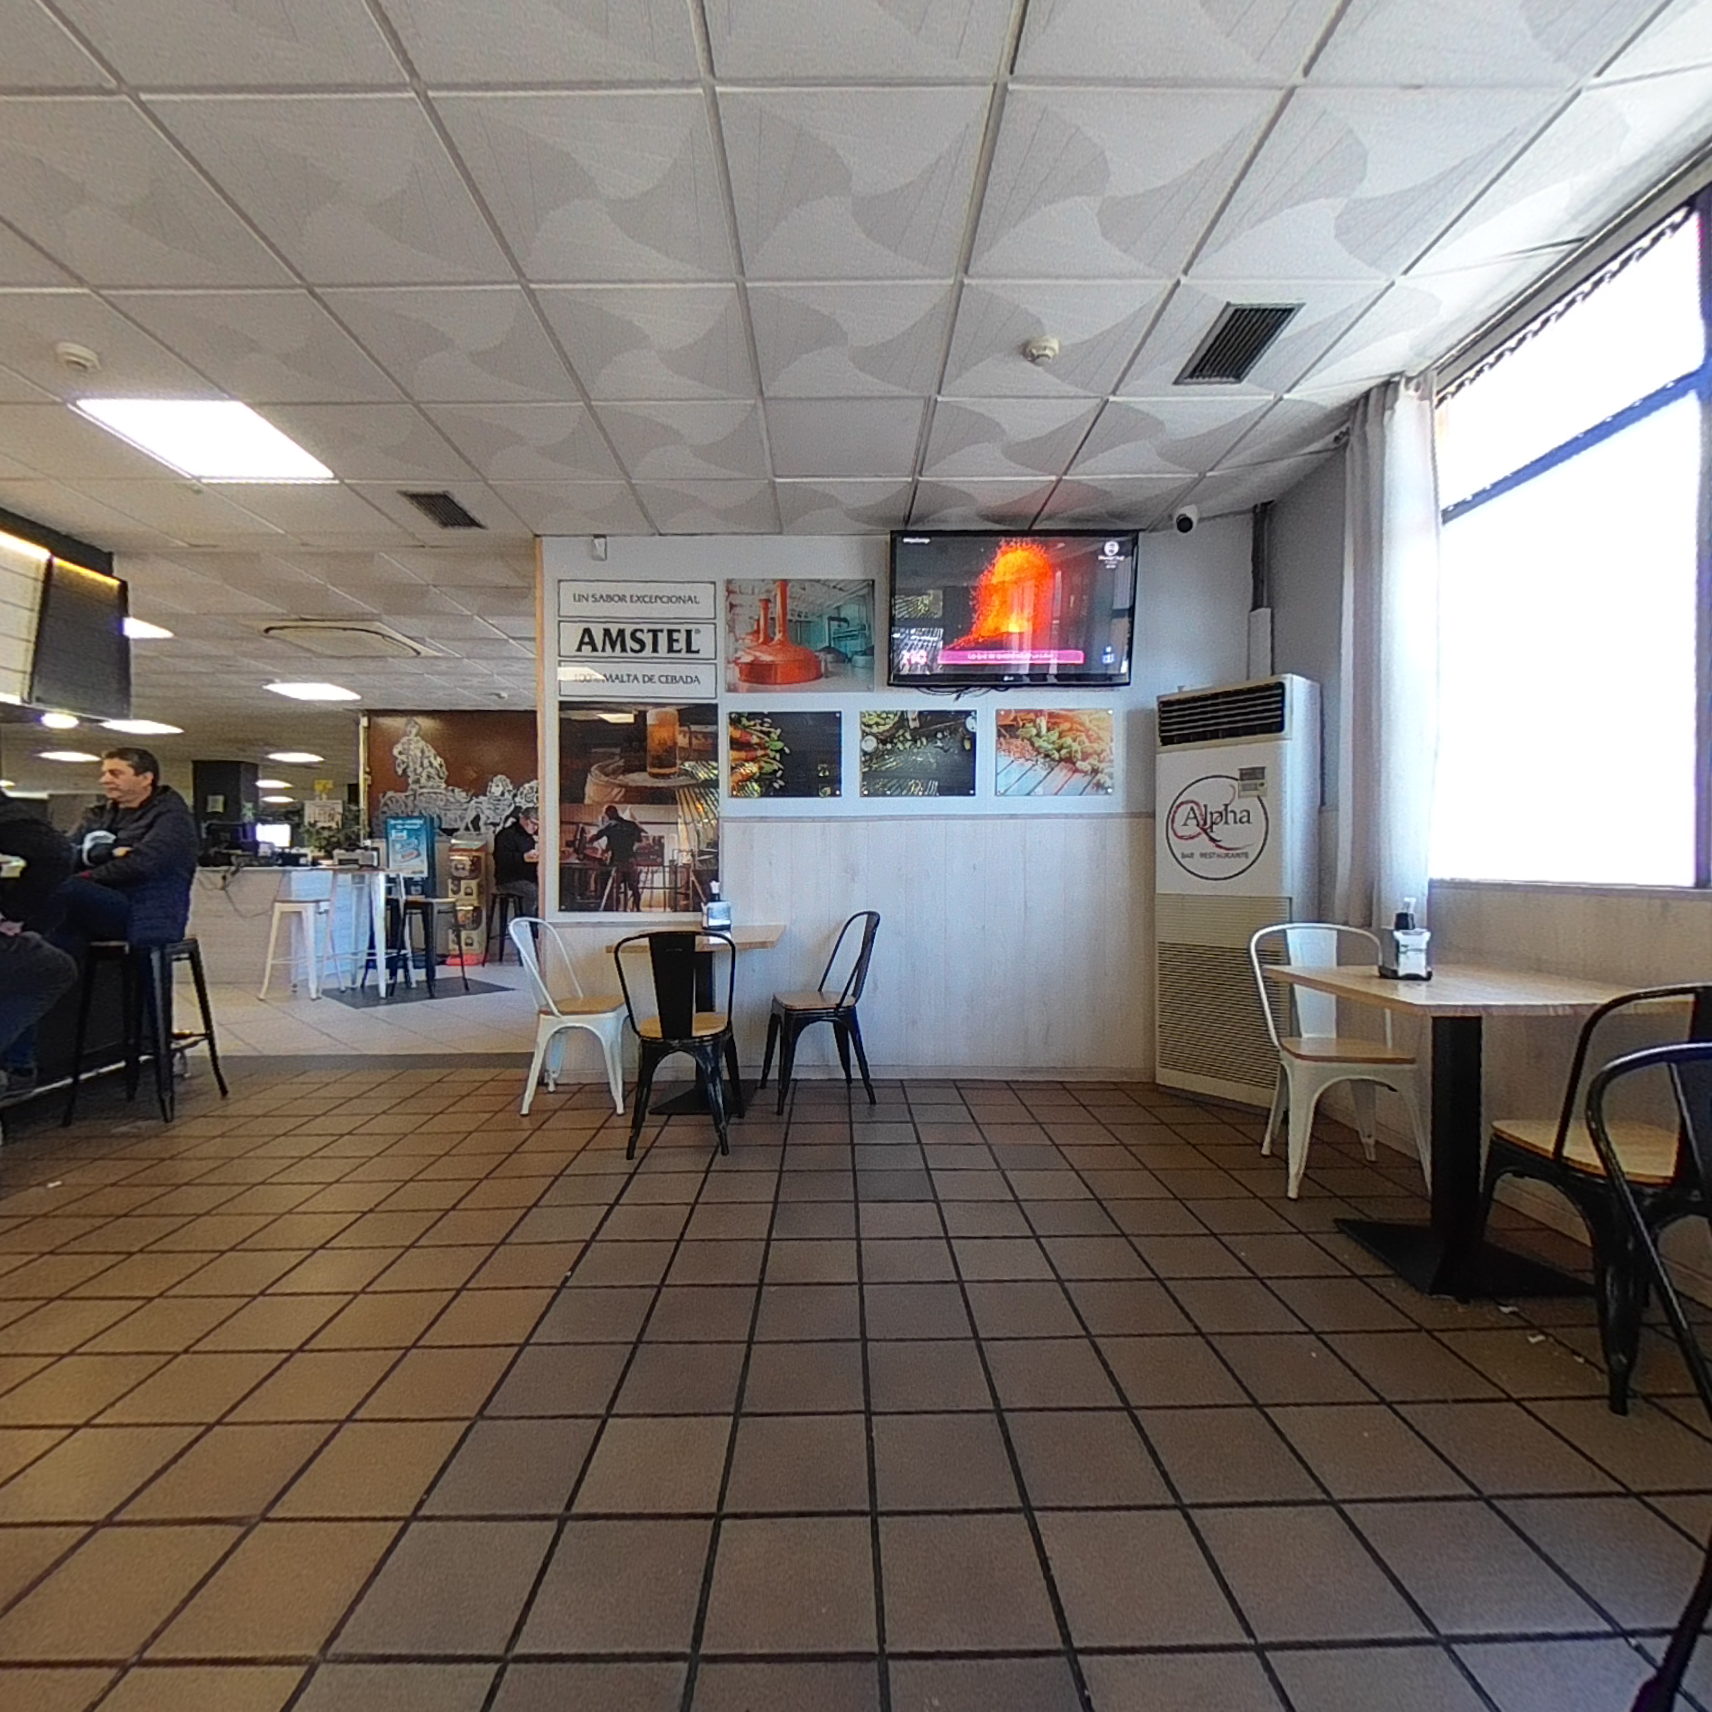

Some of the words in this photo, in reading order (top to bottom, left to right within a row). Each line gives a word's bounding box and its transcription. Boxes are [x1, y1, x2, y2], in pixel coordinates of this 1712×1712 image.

[573, 592, 589, 603] UN
[591, 593, 628, 604] SABOR
[629, 594, 701, 604] EXCEPCIONAL
[575, 627, 701, 654] AMSTEL
[603, 673, 639, 683] MALTA
[642, 674, 656, 684] DE
[658, 674, 701, 685] CEBADA
[1181, 803, 1252, 834] Alpha
